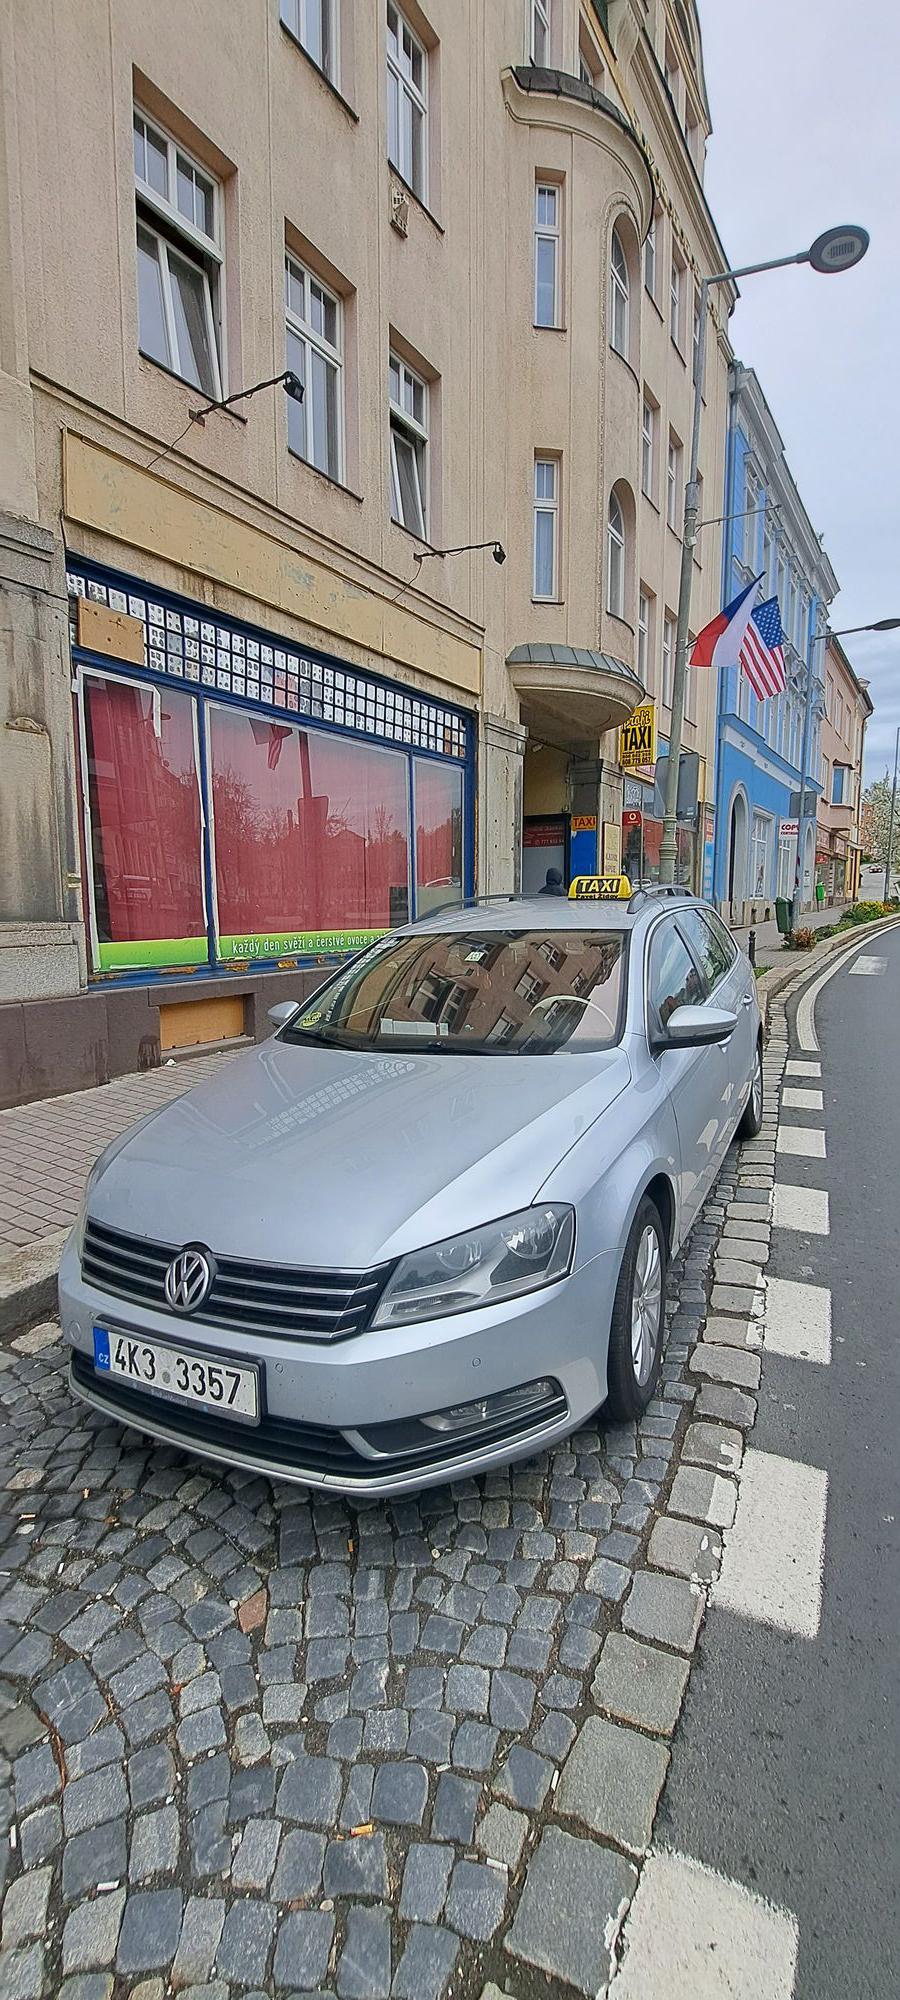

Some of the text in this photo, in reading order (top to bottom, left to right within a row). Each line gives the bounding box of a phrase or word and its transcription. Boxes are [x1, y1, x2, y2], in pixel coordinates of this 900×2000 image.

[622, 725, 652, 751] TAXI
[573, 817, 596, 827] TAXI
[580, 879, 618, 893] TAXI
[232, 938, 260, 955] každý
[264, 938, 280, 951] den
[284, 935, 305, 950] svěží
[308, 939, 313, 948] a
[317, 934, 345, 947] čerstvé
[347, 936, 368, 945] ovoce
[98, 1352, 109, 1365] CZ
[115, 1339, 156, 1380] 4K3
[176, 1357, 241, 1405] 3357
